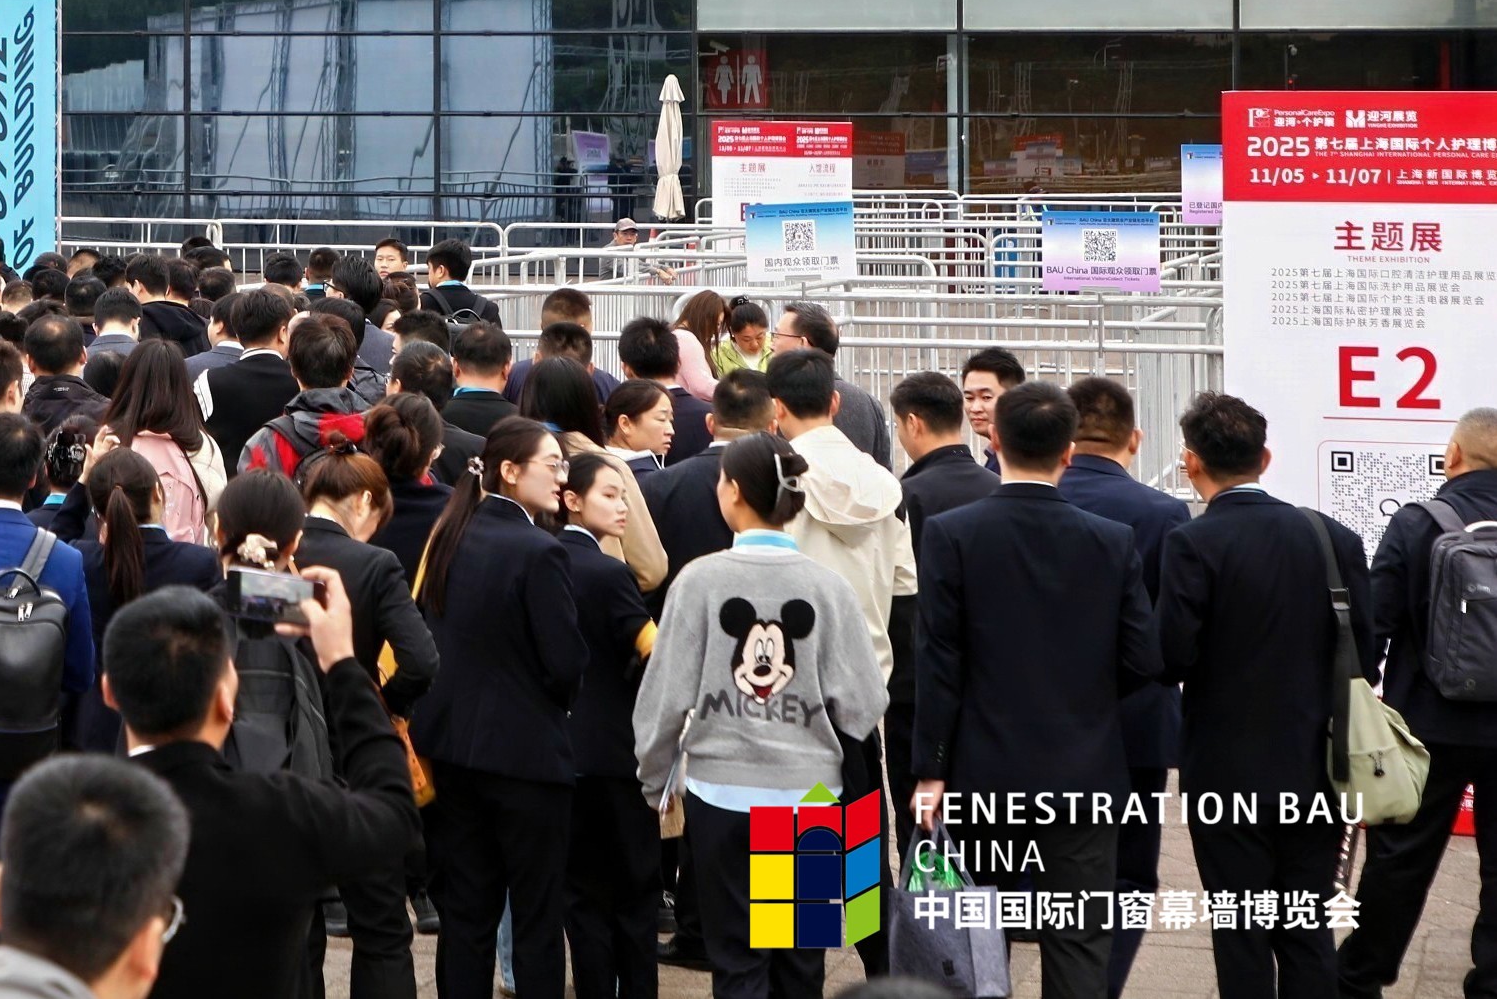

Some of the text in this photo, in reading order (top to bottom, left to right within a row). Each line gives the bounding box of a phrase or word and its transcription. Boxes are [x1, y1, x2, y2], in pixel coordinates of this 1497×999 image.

[1273, 109, 1336, 117] PersonalCareExpo
[1367, 110, 1418, 122] 迎河展览
[13, 4, 35, 270] OF BUILDING
[1247, 136, 1310, 157] 2025
[1249, 168, 1382, 187] 11/05 11/07
[1333, 220, 1443, 252] 主题展
[764, 255, 839, 267] 国内观众领取门票
[1347, 255, 1431, 264] THEME EXHIBITION
[1046, 266, 1157, 276] BAU China 国际观众领取门票
[1271, 280, 1461, 293] 2025第七届上海国际洗护用品展览会
[1271, 305, 1426, 317] 2025上海国际私密护理展览会
[1271, 316, 1426, 329] 2025上海国际护肤芳香展览会
[1338, 345, 1441, 410] E2
[700, 689, 823, 728] MICKEY
